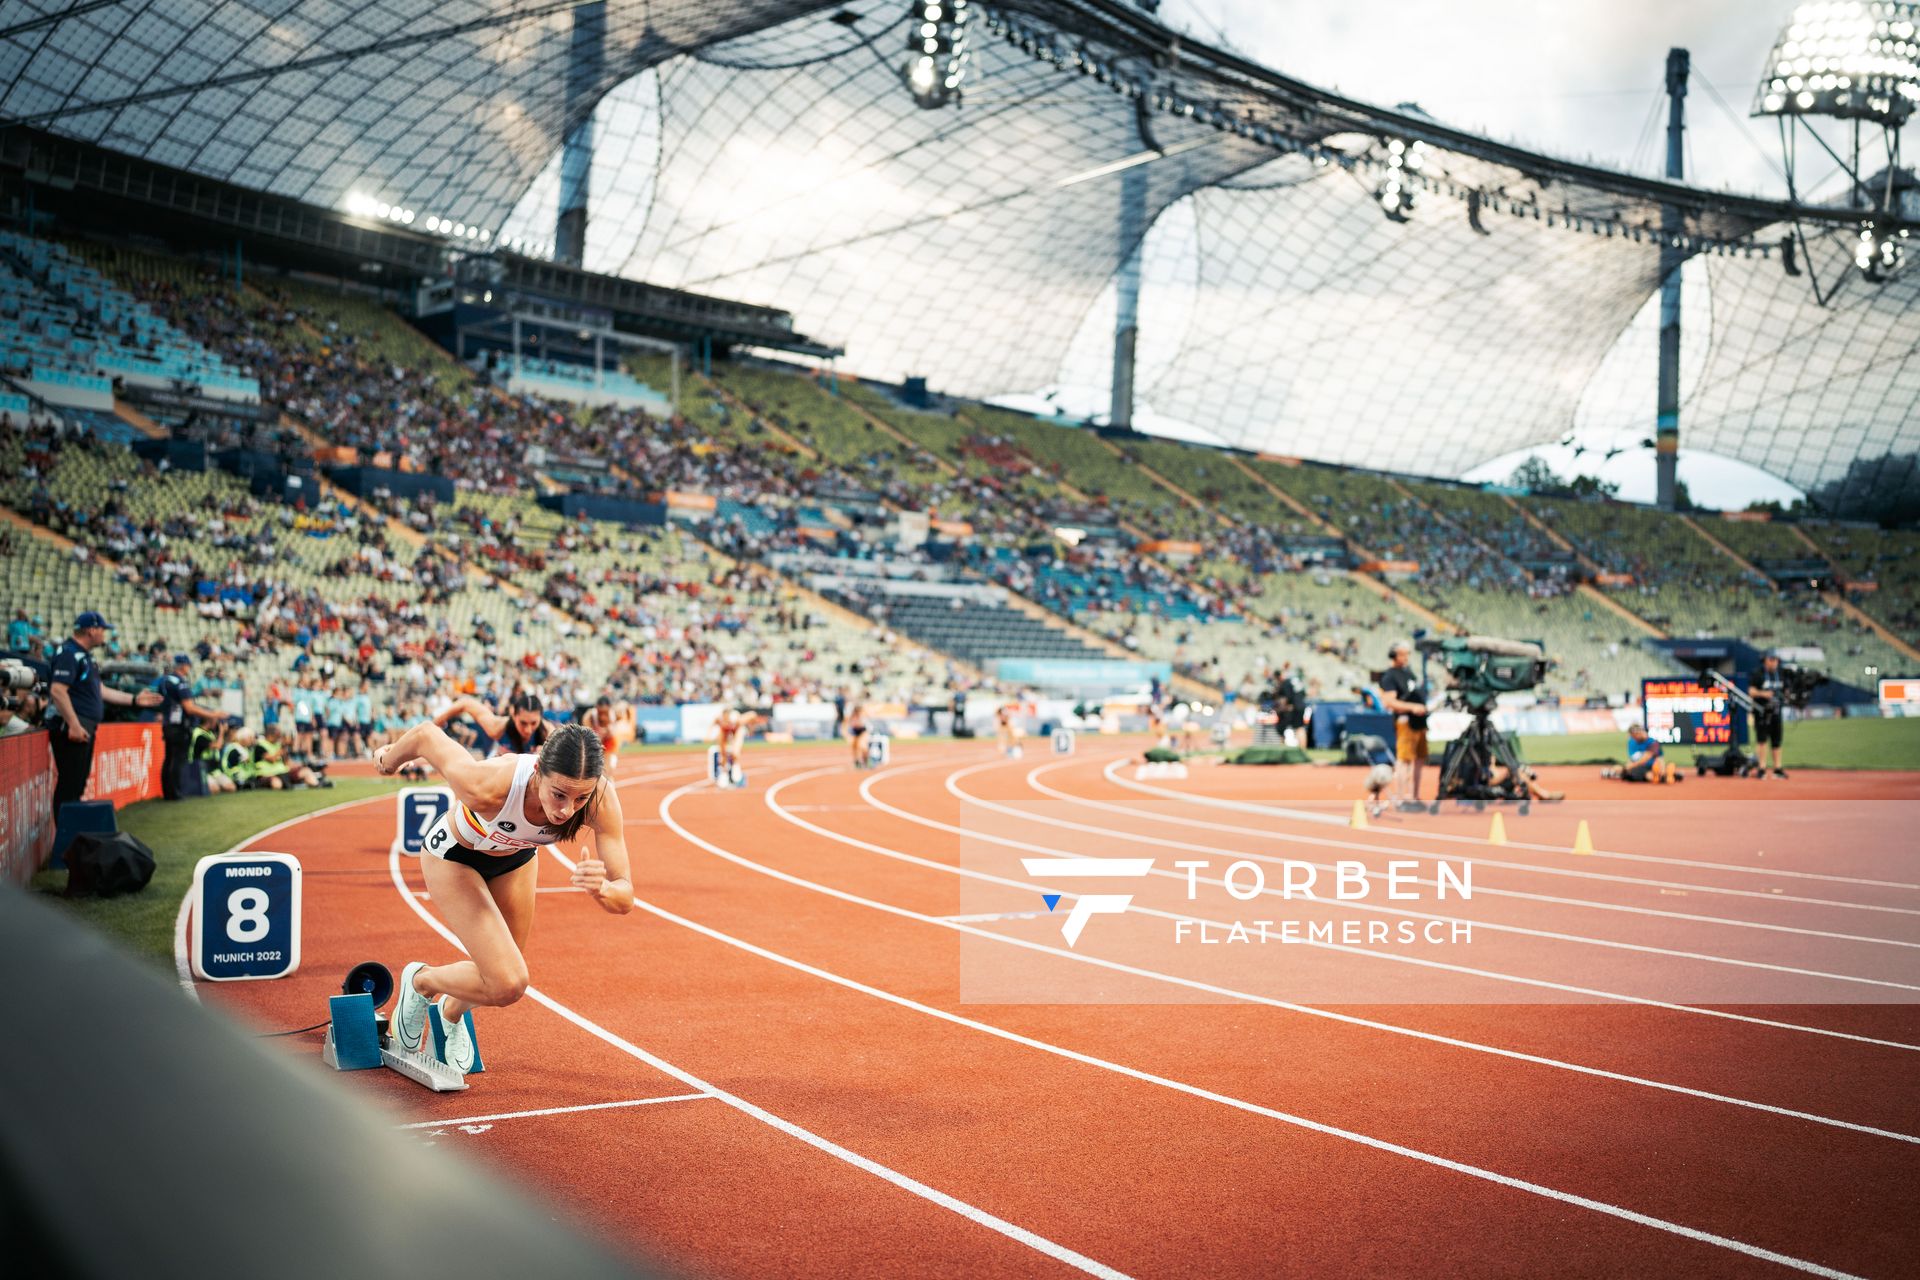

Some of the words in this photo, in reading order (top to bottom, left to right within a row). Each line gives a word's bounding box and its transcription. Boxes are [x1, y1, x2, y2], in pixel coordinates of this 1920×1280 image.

[415, 804, 438, 837] 7
[430, 828, 448, 850] 8
[225, 866, 272, 878] MONDO
[226, 886, 271, 943] 8
[213, 952, 254, 964] MUNICH
[256, 950, 282, 961] 2022
